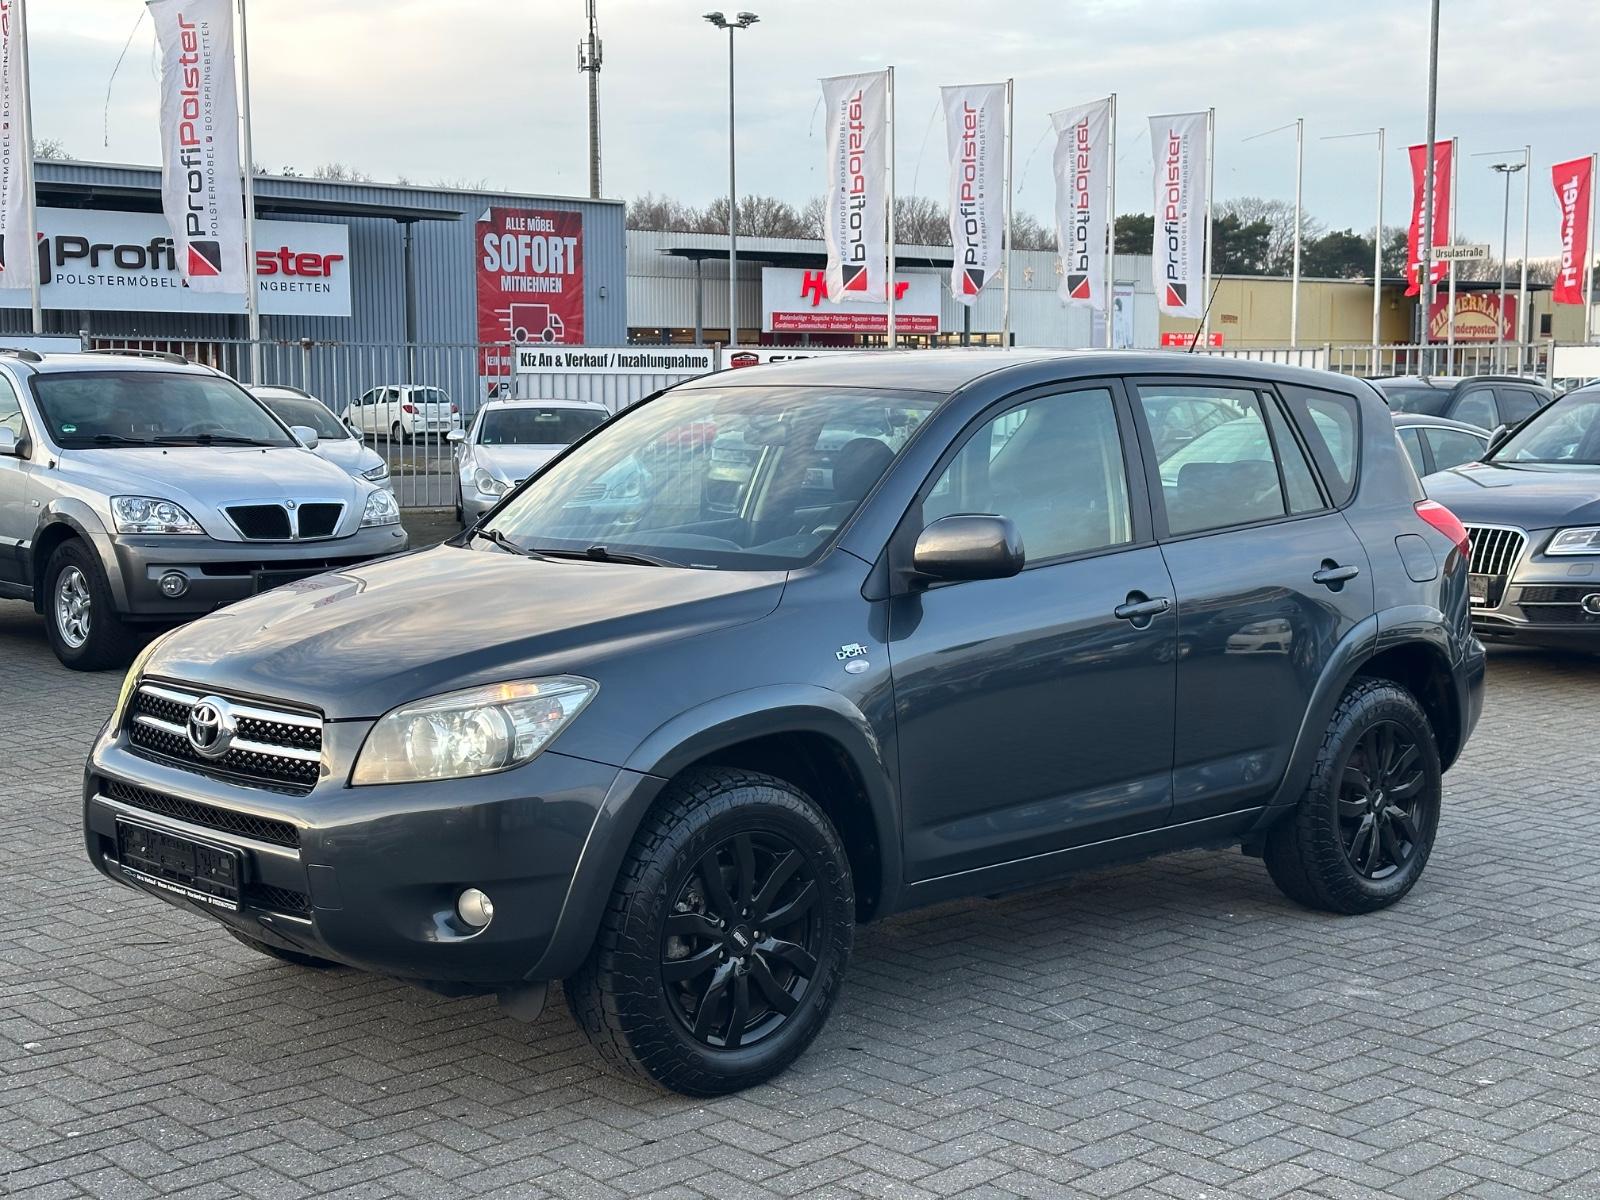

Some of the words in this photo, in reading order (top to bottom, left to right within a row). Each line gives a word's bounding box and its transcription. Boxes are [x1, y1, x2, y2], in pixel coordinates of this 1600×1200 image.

[201, 22, 213, 130] BOXSPRINGBETTEN
[178, 13, 206, 236] ProfiPolster
[206, 146, 219, 236] POLSTERMÖBEL
[961, 101, 978, 265] ProfiPolster
[505, 217, 525, 230] ALLE
[527, 216, 555, 232] MÖBEL
[1165, 129, 1180, 280] ProfiPolster
[484, 233, 577, 274] SOFORT
[1435, 247, 1484, 257] Ursulastraße
[56, 273, 177, 288] POLSTERMÖBEL
[501, 275, 562, 293] MITNEHMEN
[520, 353, 537, 367] Kfz
[538, 353, 552, 367] An
[555, 354, 563, 367] &
[565, 353, 609, 368] Verkauf
[618, 354, 708, 369] Inzahlungnahme
